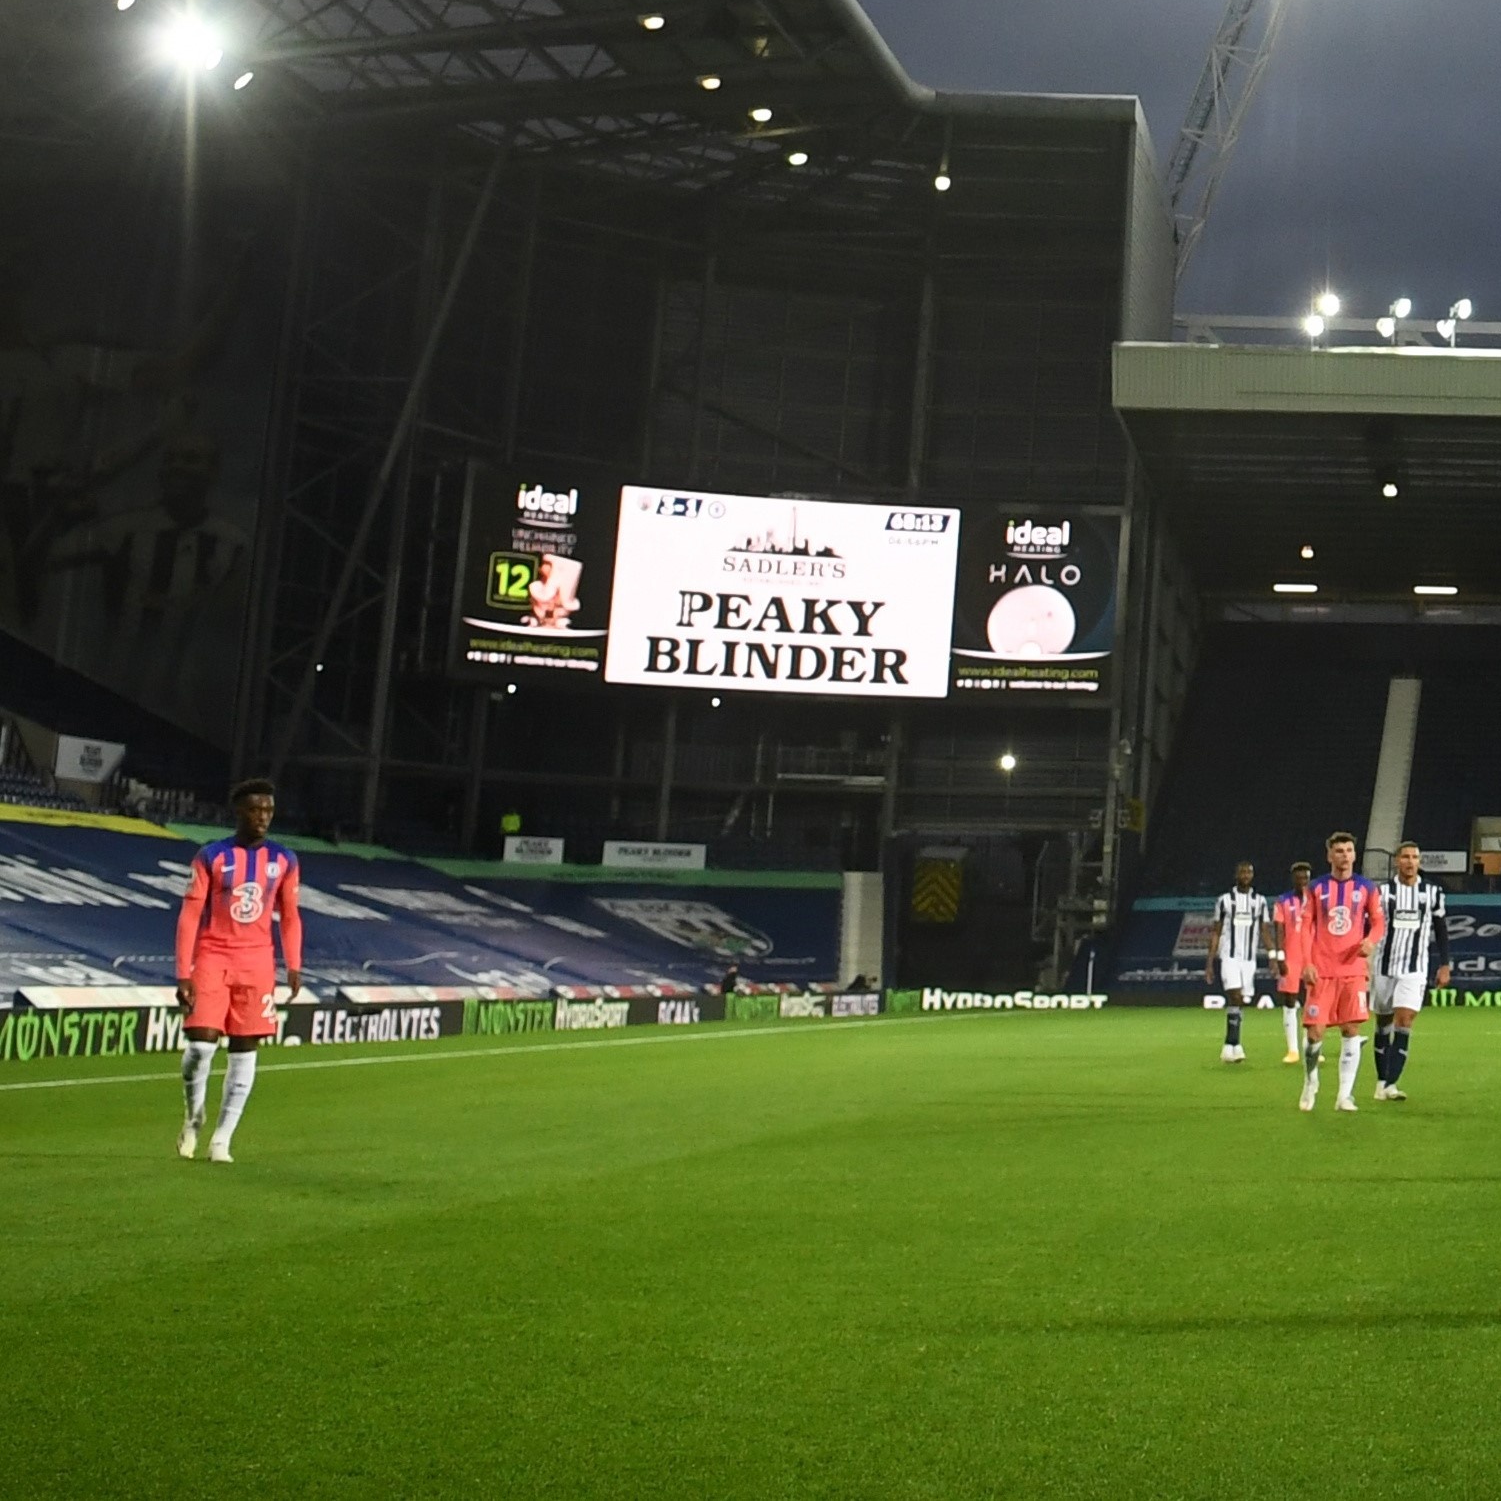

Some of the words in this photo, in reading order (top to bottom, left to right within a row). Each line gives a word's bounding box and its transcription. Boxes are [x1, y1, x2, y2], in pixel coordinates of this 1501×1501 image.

[518, 483, 578, 515] ideal
[1006, 519, 1071, 546] ideal
[495, 561, 531, 598] 12
[722, 556, 846, 579] SADLER'S
[988, 563, 1082, 586] HALO
[676, 590, 886, 637] PEAKY
[643, 635, 910, 685] BLINDER
[311, 1006, 441, 1045] ELECTROLYTES
